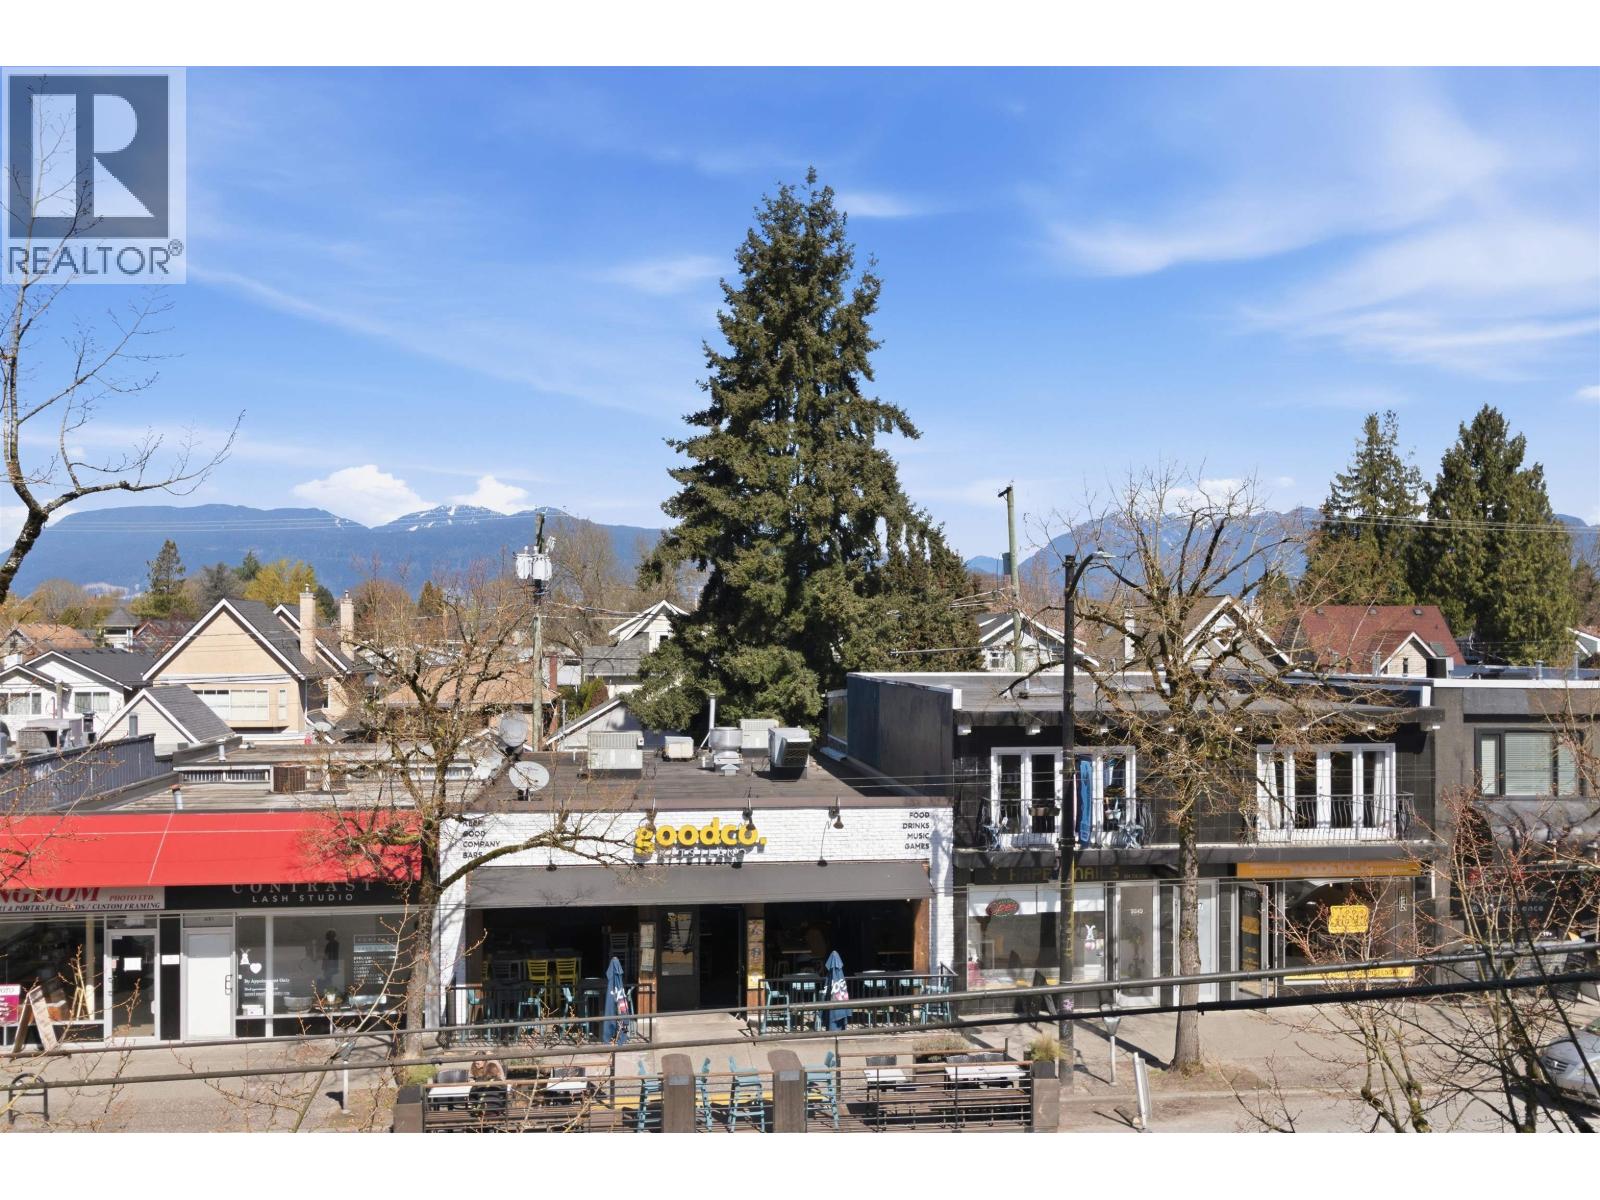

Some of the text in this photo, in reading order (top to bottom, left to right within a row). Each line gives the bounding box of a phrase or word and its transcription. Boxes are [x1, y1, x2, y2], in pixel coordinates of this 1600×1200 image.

[902, 822, 930, 830] DRINKS
[635, 817, 767, 854] goodco.
[907, 832, 930, 840] MUSIC
[462, 840, 501, 848] COMPANY
[904, 842, 930, 850] GAMES
[462, 851, 483, 859] BARS
[231, 879, 372, 894] CONTRAST
[252, 893, 354, 903] LASH STUDIO
[92, 902, 122, 910] CUSTOM
